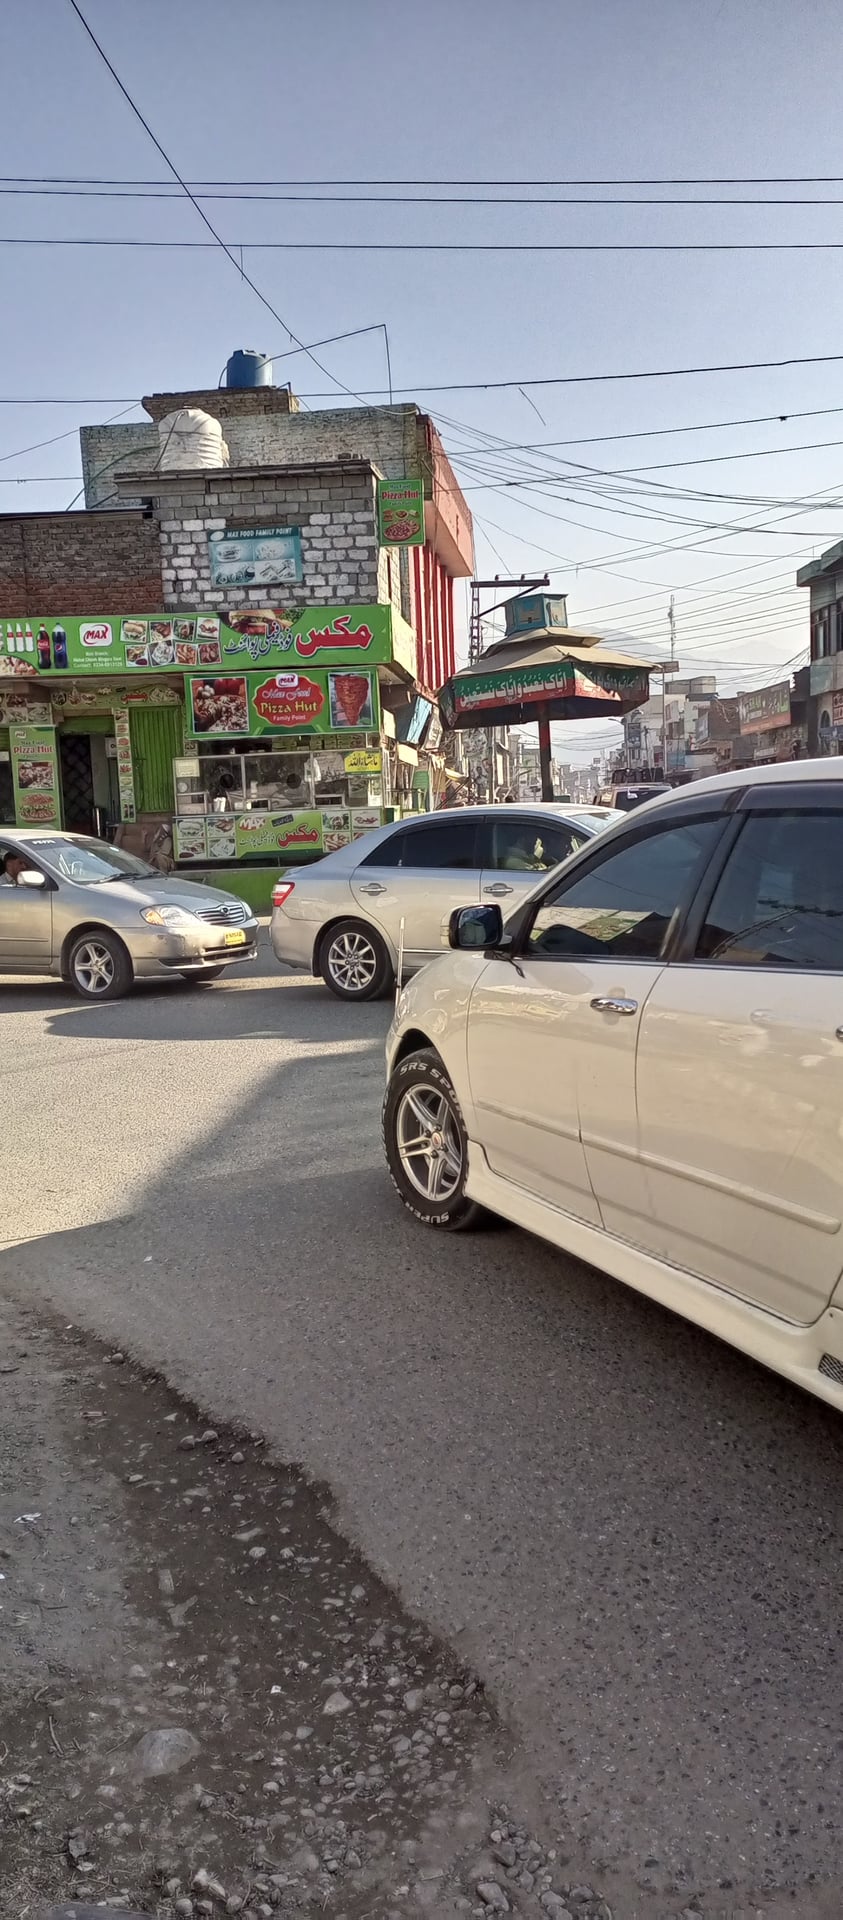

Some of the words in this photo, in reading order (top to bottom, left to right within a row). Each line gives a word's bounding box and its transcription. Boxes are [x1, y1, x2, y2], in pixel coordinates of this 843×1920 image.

[404, 490, 419, 498] Hut
[86, 630, 107, 640] MAX
[295, 615, 373, 656] مکس
[261, 702, 292, 713] Pizza
[295, 701, 317, 712] Hut
[14, 746, 35, 754] Pizza
[37, 745, 53, 753] Hut
[240, 818, 265, 829] MAX
[277, 824, 319, 848] مکس
[400, 1062, 429, 1076] SRS
